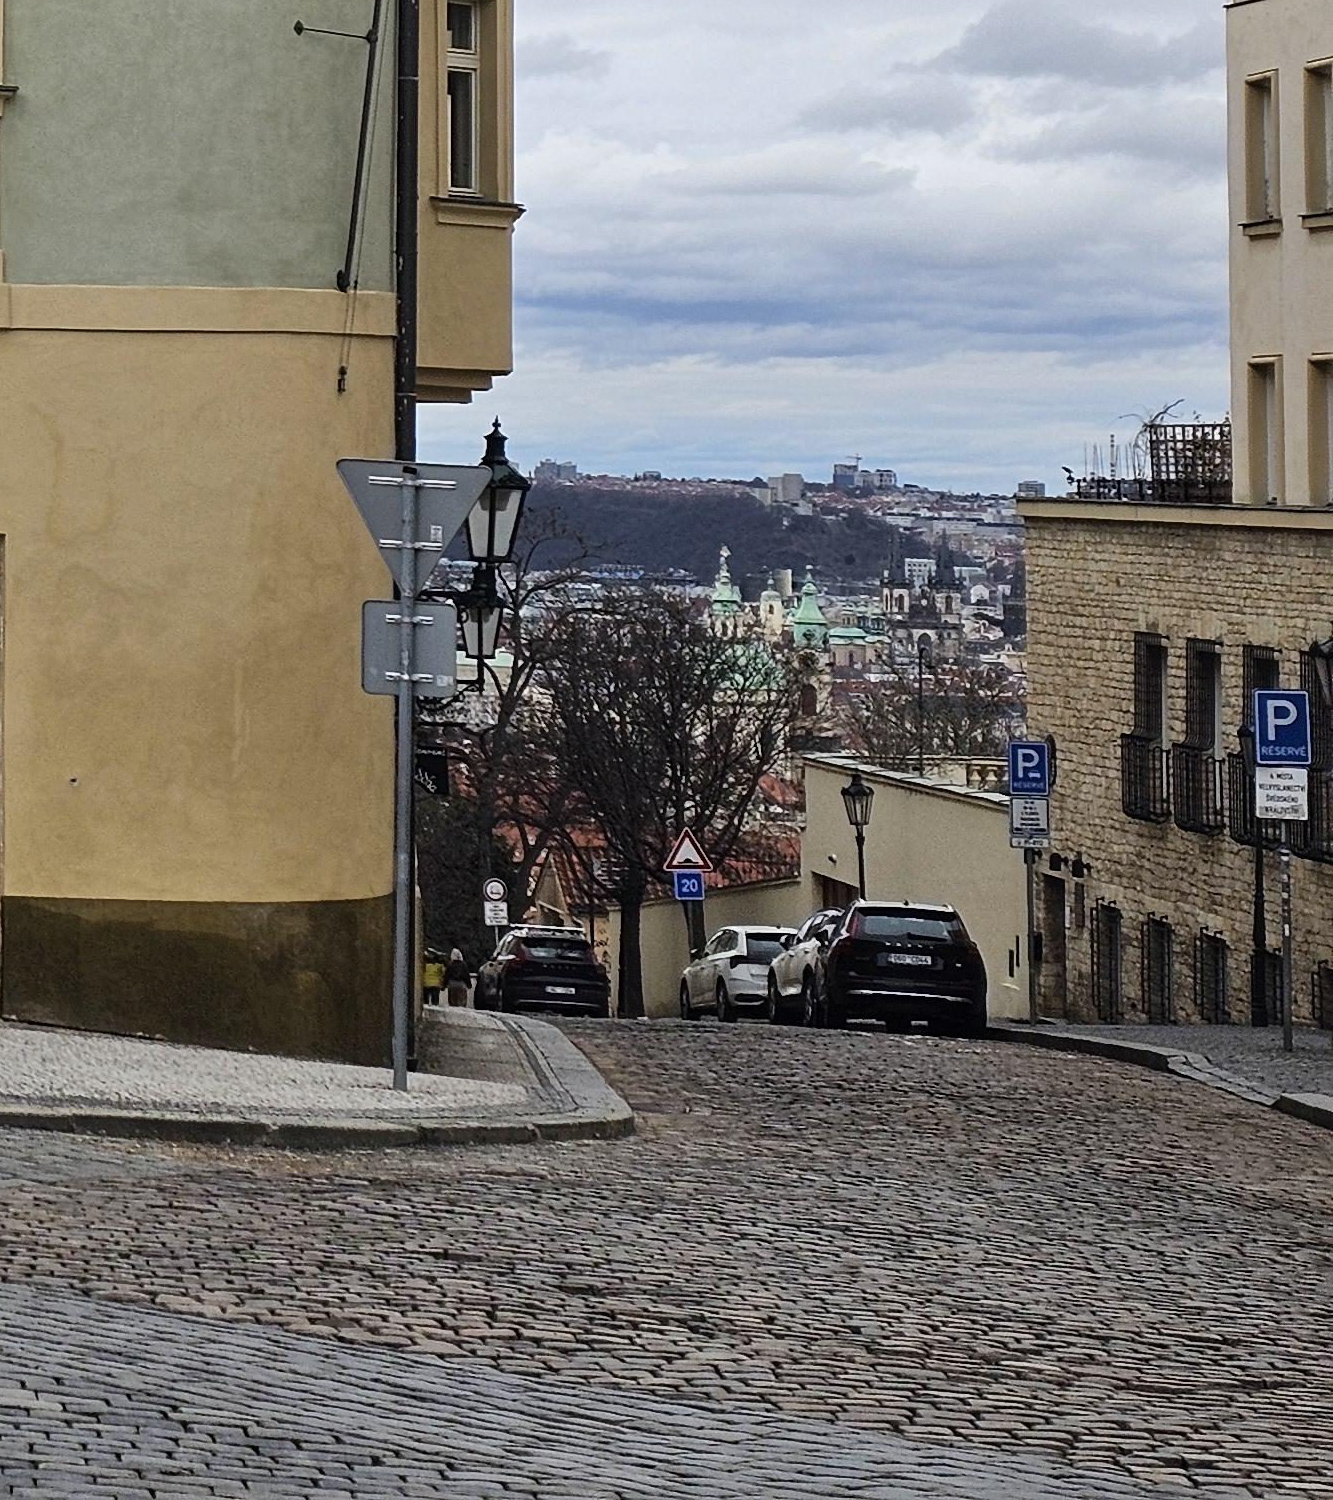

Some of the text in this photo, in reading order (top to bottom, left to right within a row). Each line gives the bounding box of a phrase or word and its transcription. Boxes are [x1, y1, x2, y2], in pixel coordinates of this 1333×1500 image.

[1266, 699, 1298, 741] P
[1261, 745, 1307, 756] RÉSERVÉ
[1017, 748, 1040, 778] P
[681, 879, 699, 893] 20
